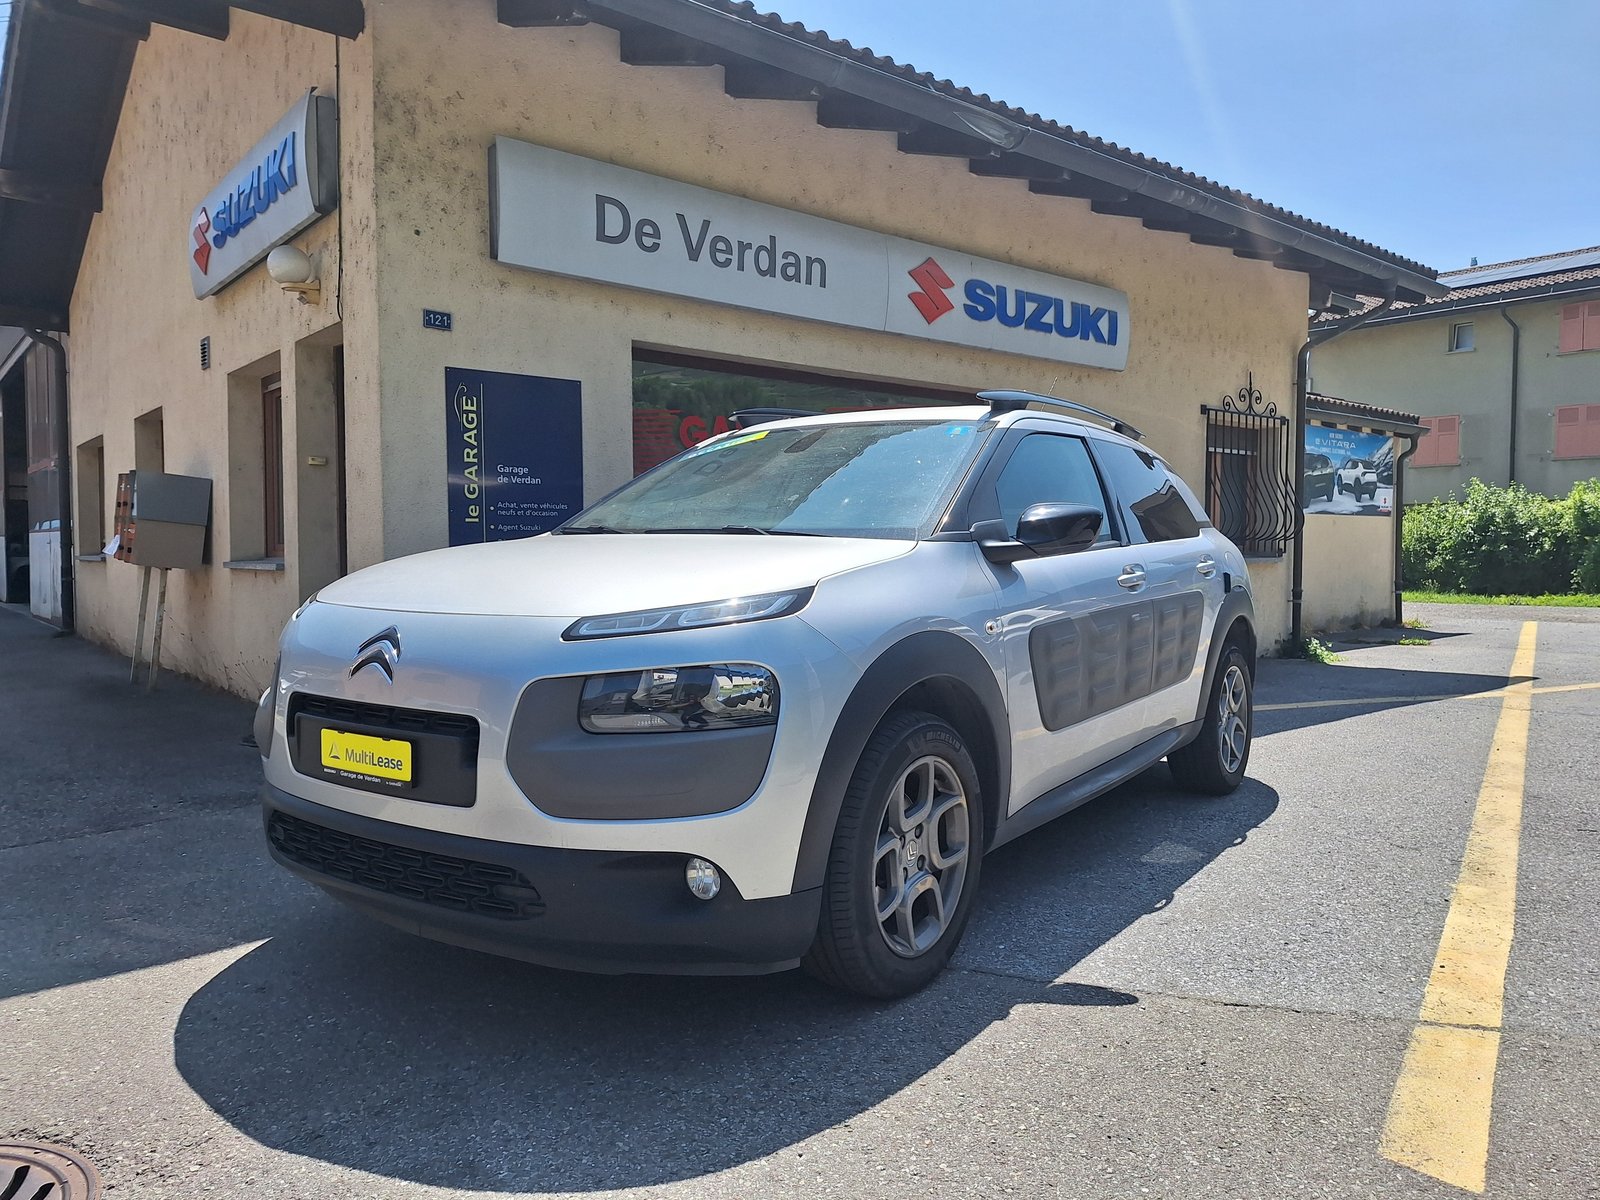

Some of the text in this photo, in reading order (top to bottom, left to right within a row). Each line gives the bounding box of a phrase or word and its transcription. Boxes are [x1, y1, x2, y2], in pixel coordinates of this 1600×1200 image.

[212, 131, 298, 249] SUZUKI
[595, 193, 827, 289] De Verdan
[962, 278, 1119, 347] SUZUKI
[429, 313, 447, 327] 121
[462, 395, 480, 523] le GARAGE
[497, 464, 529, 476] Garage
[497, 474, 542, 485] de Verdan
[497, 501, 519, 509] Achat,
[539, 502, 568, 510] véhicules
[525, 509, 559, 517] d'occasion
[497, 524, 519, 532] Agent
[926, 731, 961, 750] MICHELIN
[345, 747, 404, 771] MultiLease
[340, 770, 357, 779] Garage
[364, 774, 382, 783] Verdan
